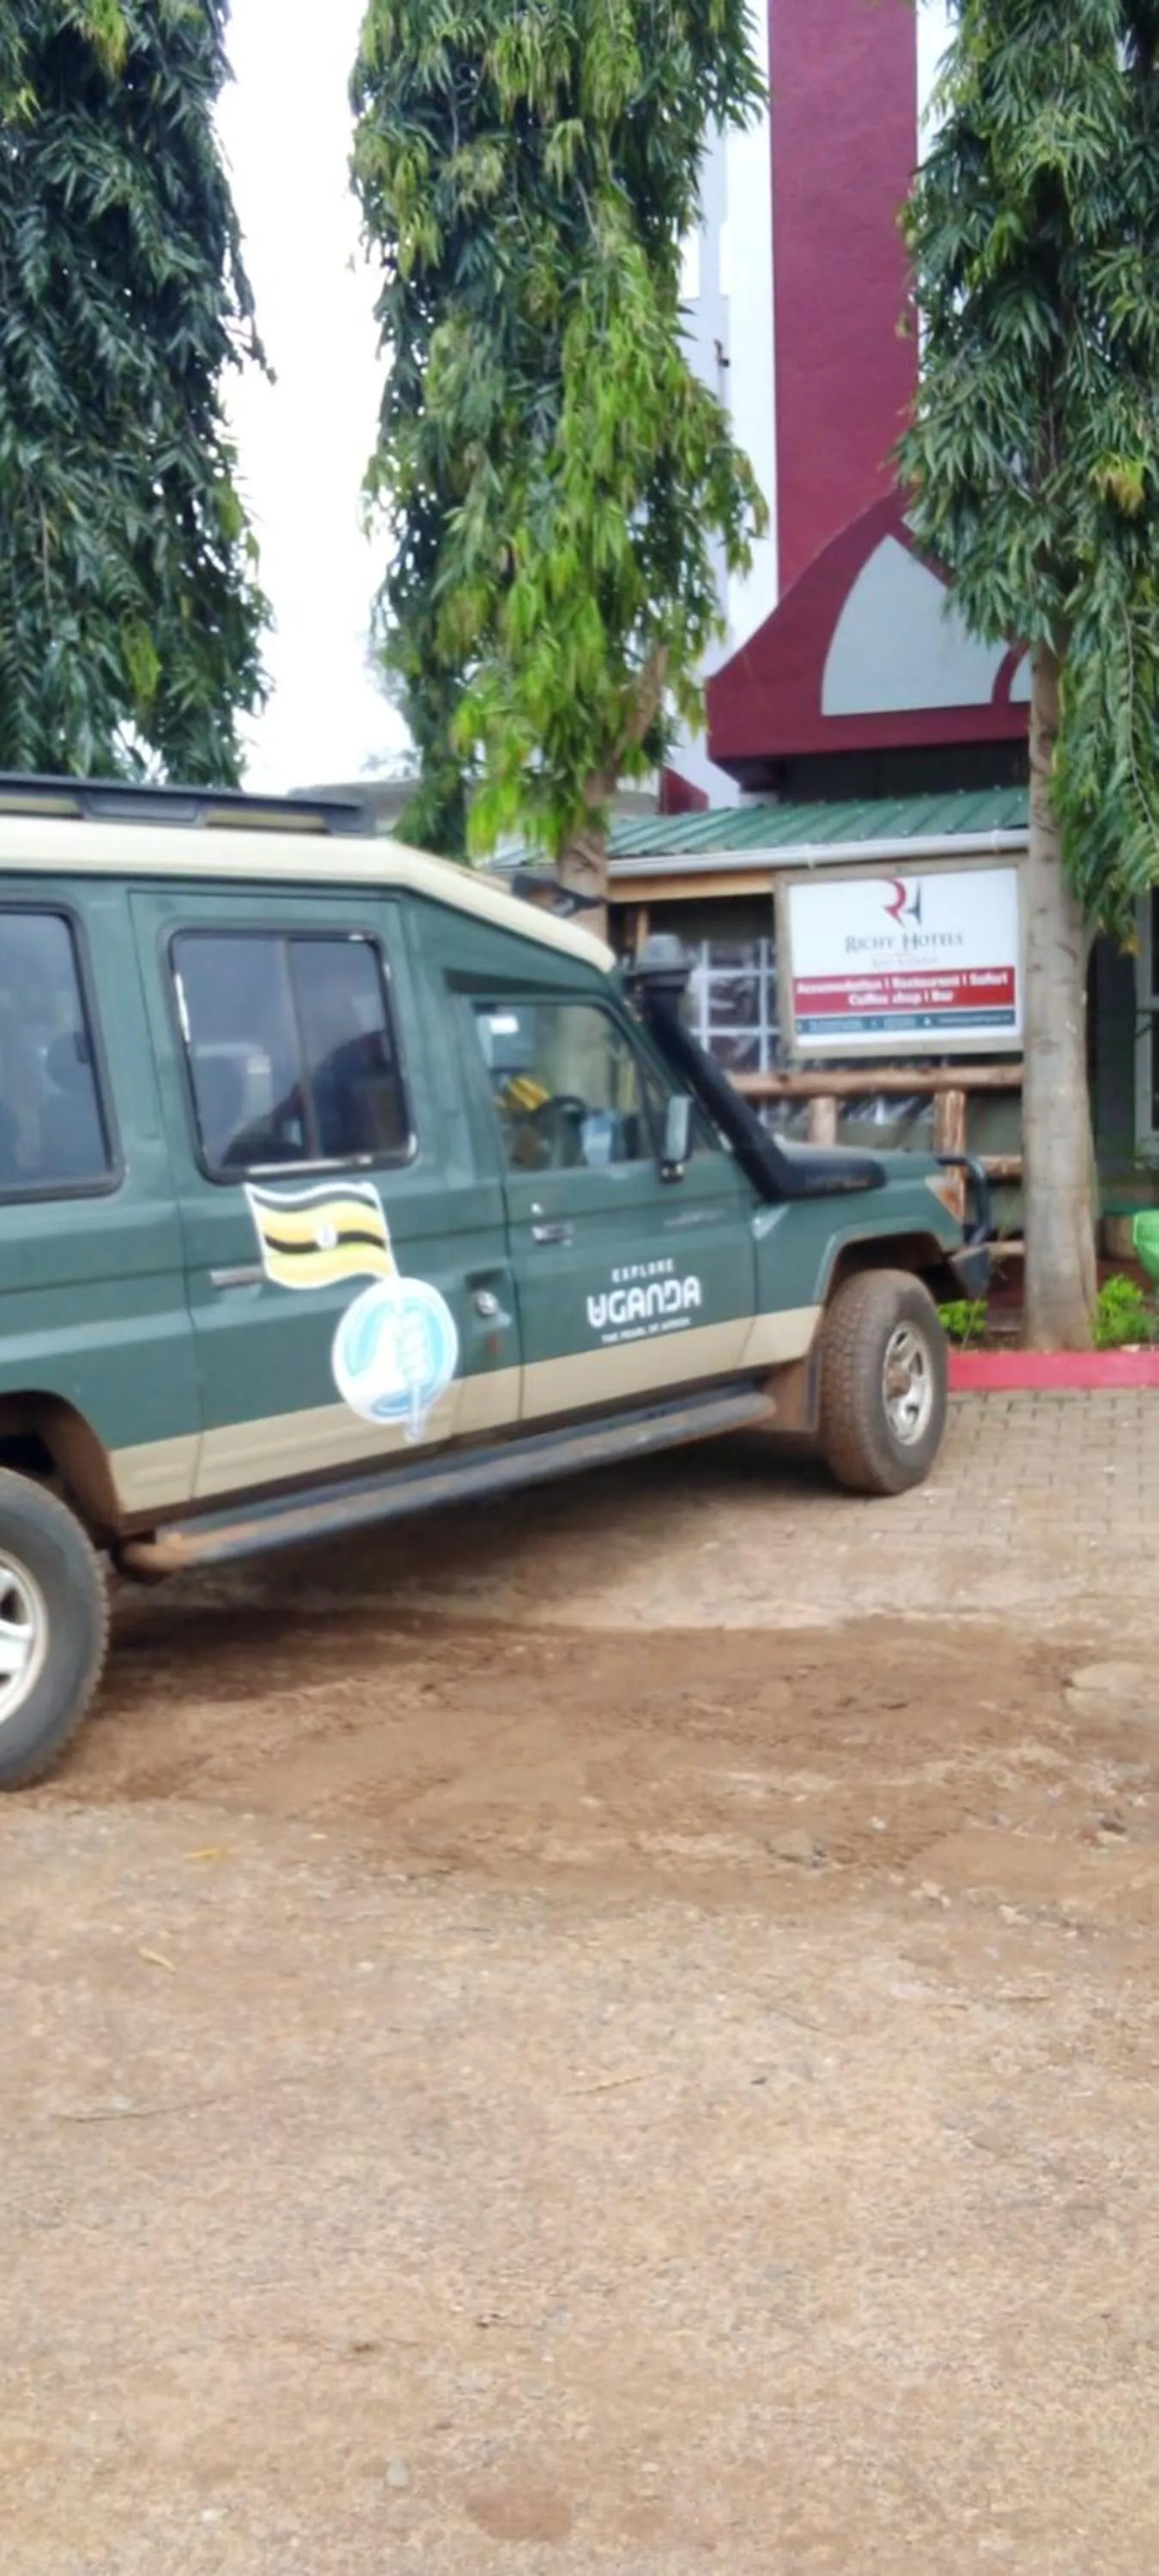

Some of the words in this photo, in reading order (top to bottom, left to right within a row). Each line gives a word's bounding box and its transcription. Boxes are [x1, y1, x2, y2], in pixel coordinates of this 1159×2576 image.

[892, 975, 960, 990] Restaurant
[848, 992, 888, 1005] Coffee
[931, 988, 954, 1003] Bar
[611, 1257, 674, 1284] EXPLORE
[586, 1275, 702, 1328] UGANDA
